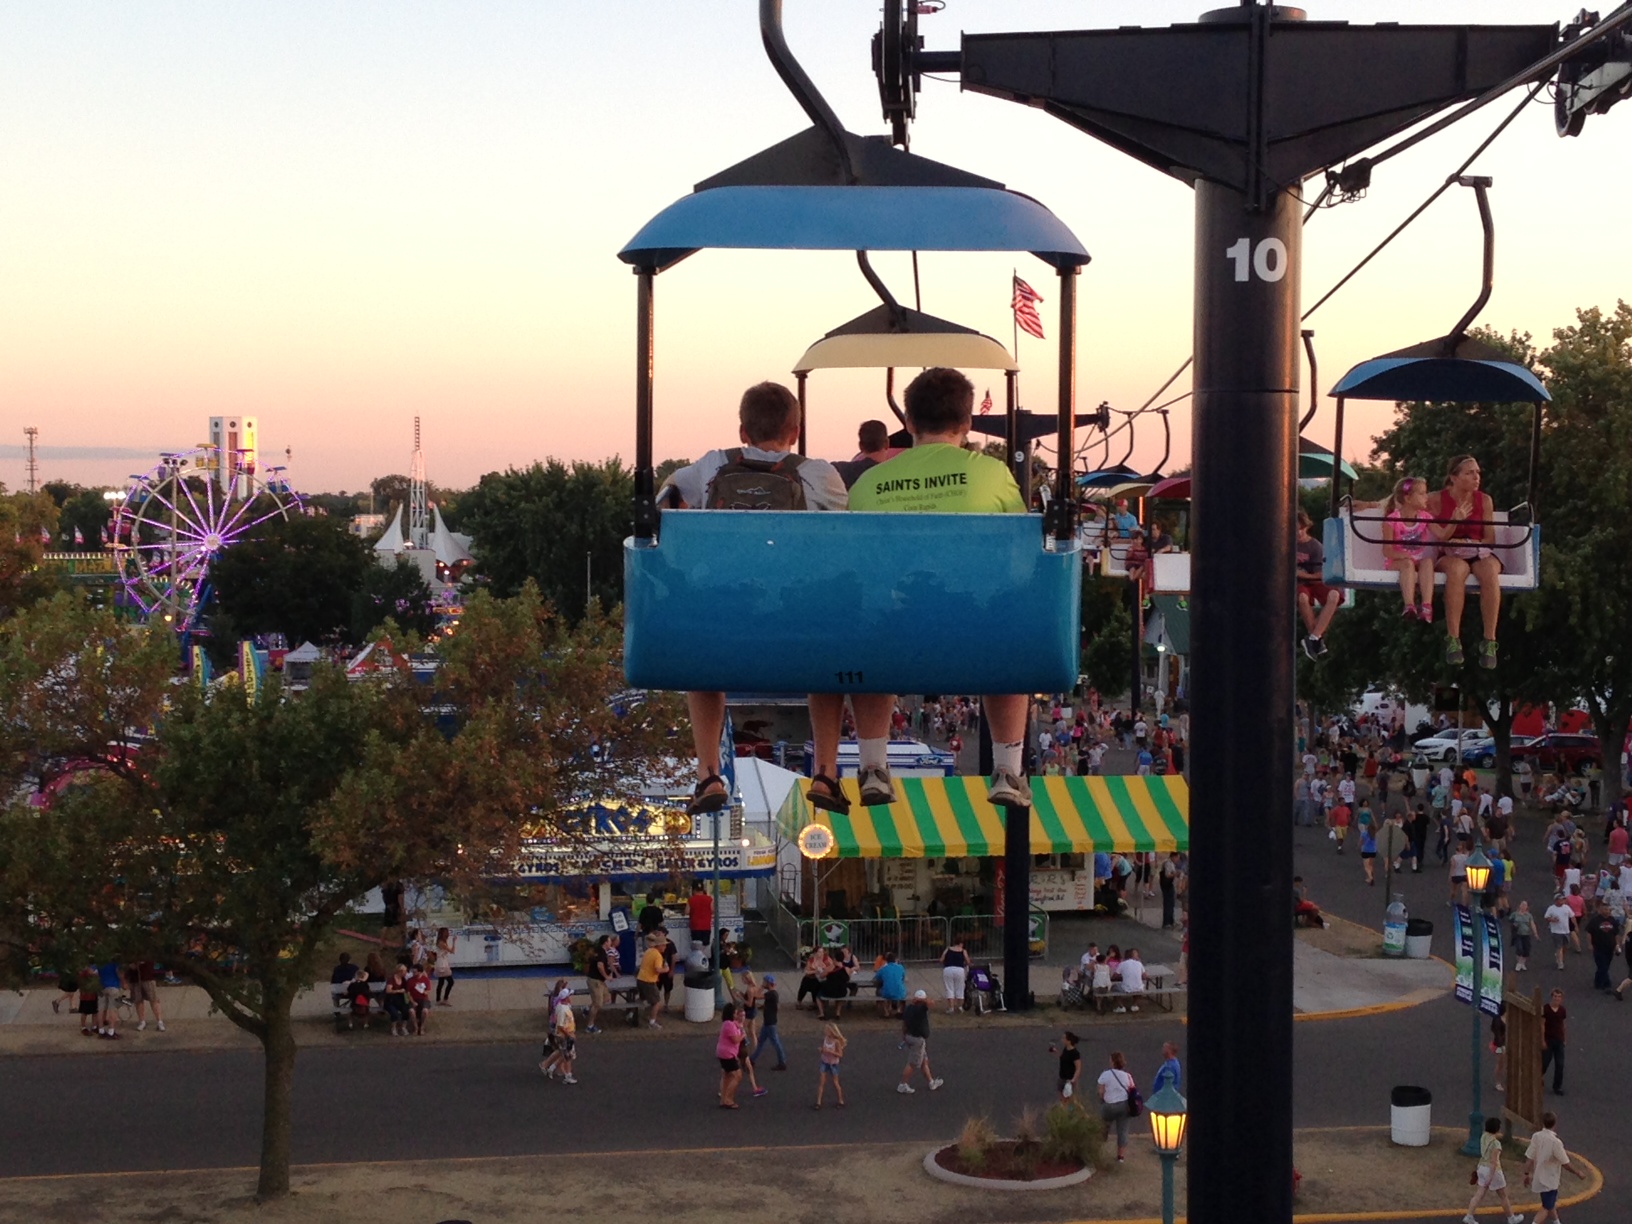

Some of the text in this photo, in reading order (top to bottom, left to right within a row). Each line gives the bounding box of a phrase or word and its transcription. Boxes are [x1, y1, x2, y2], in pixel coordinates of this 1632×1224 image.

[1226, 237, 1288, 282] 10
[1014, 450, 1025, 463] 9
[876, 473, 968, 495] SAINTS INVITE
[835, 671, 863, 684] 111
[697, 856, 739, 868] GYROS
